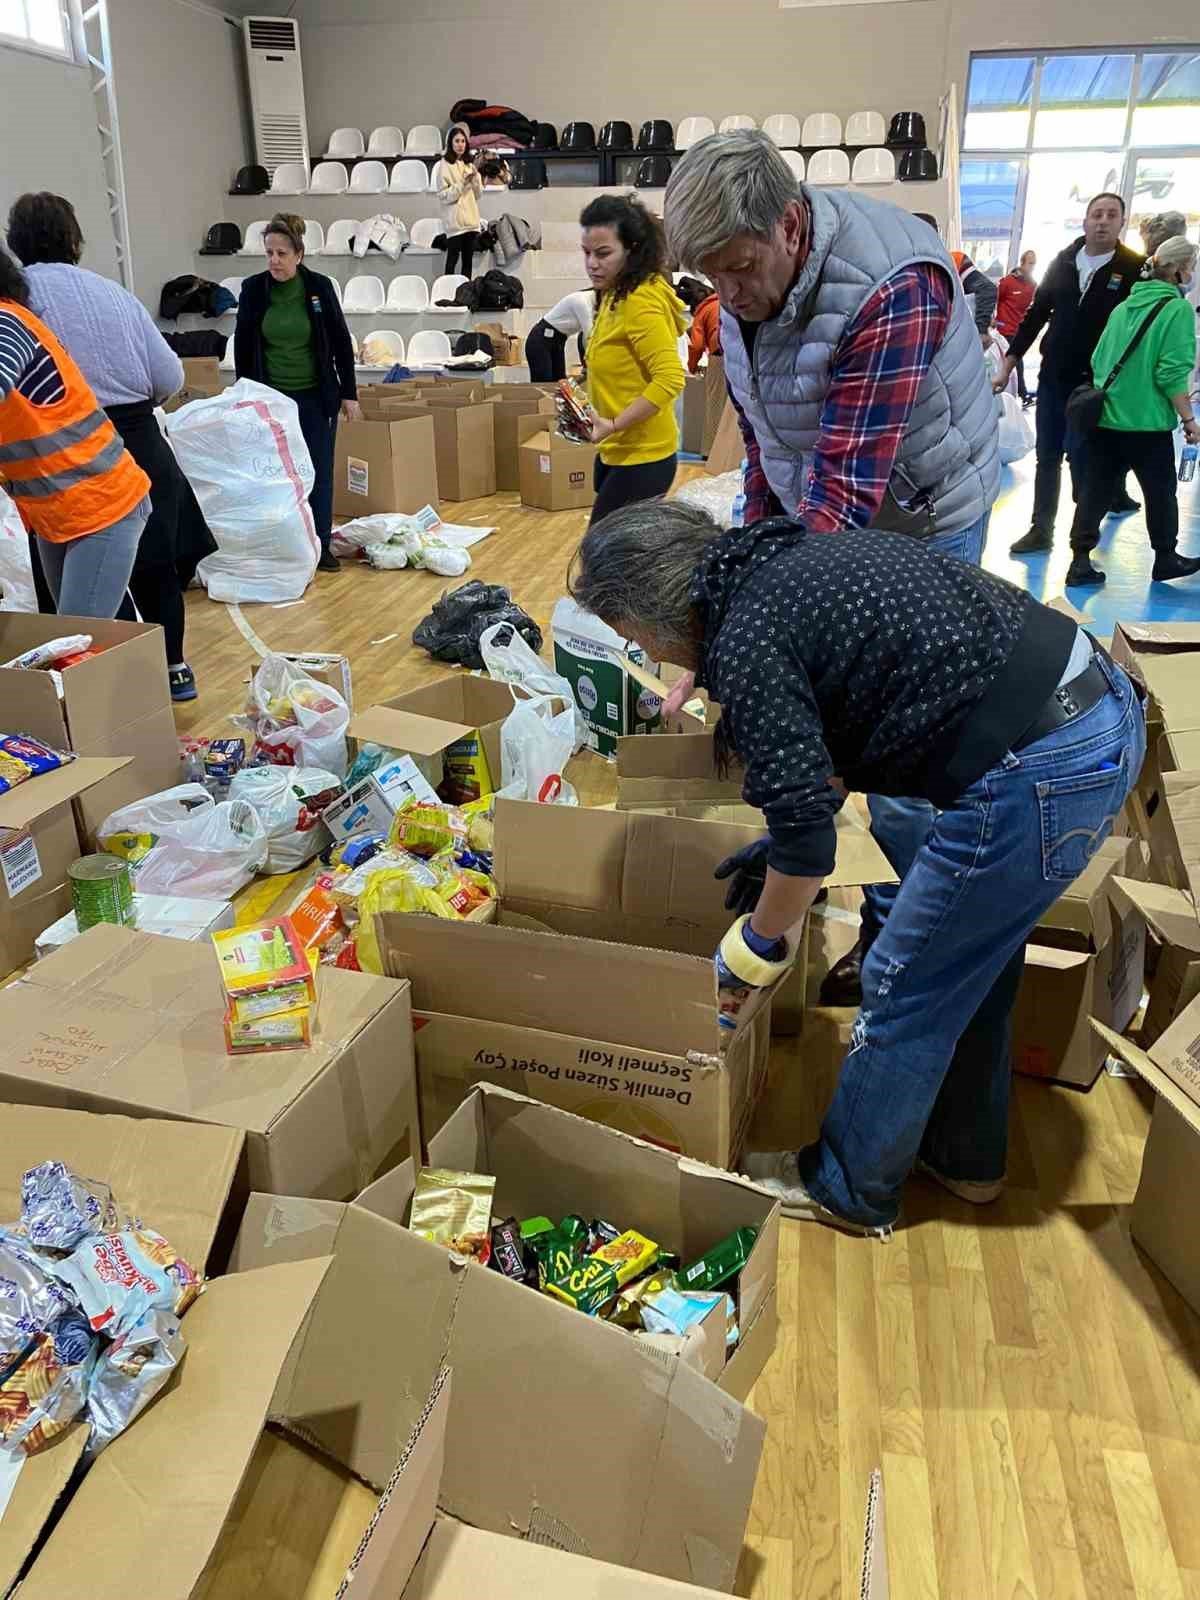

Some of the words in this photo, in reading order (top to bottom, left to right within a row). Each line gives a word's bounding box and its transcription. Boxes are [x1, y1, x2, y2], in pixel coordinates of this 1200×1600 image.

[473, 1050, 507, 1070] Çay
[511, 1058, 561, 1080] Poşet
[578, 1048, 615, 1068] Koli
[617, 1053, 693, 1082] Seçmeli
[564, 1067, 620, 1092] Süzen
[623, 1080, 692, 1105] Demlik
